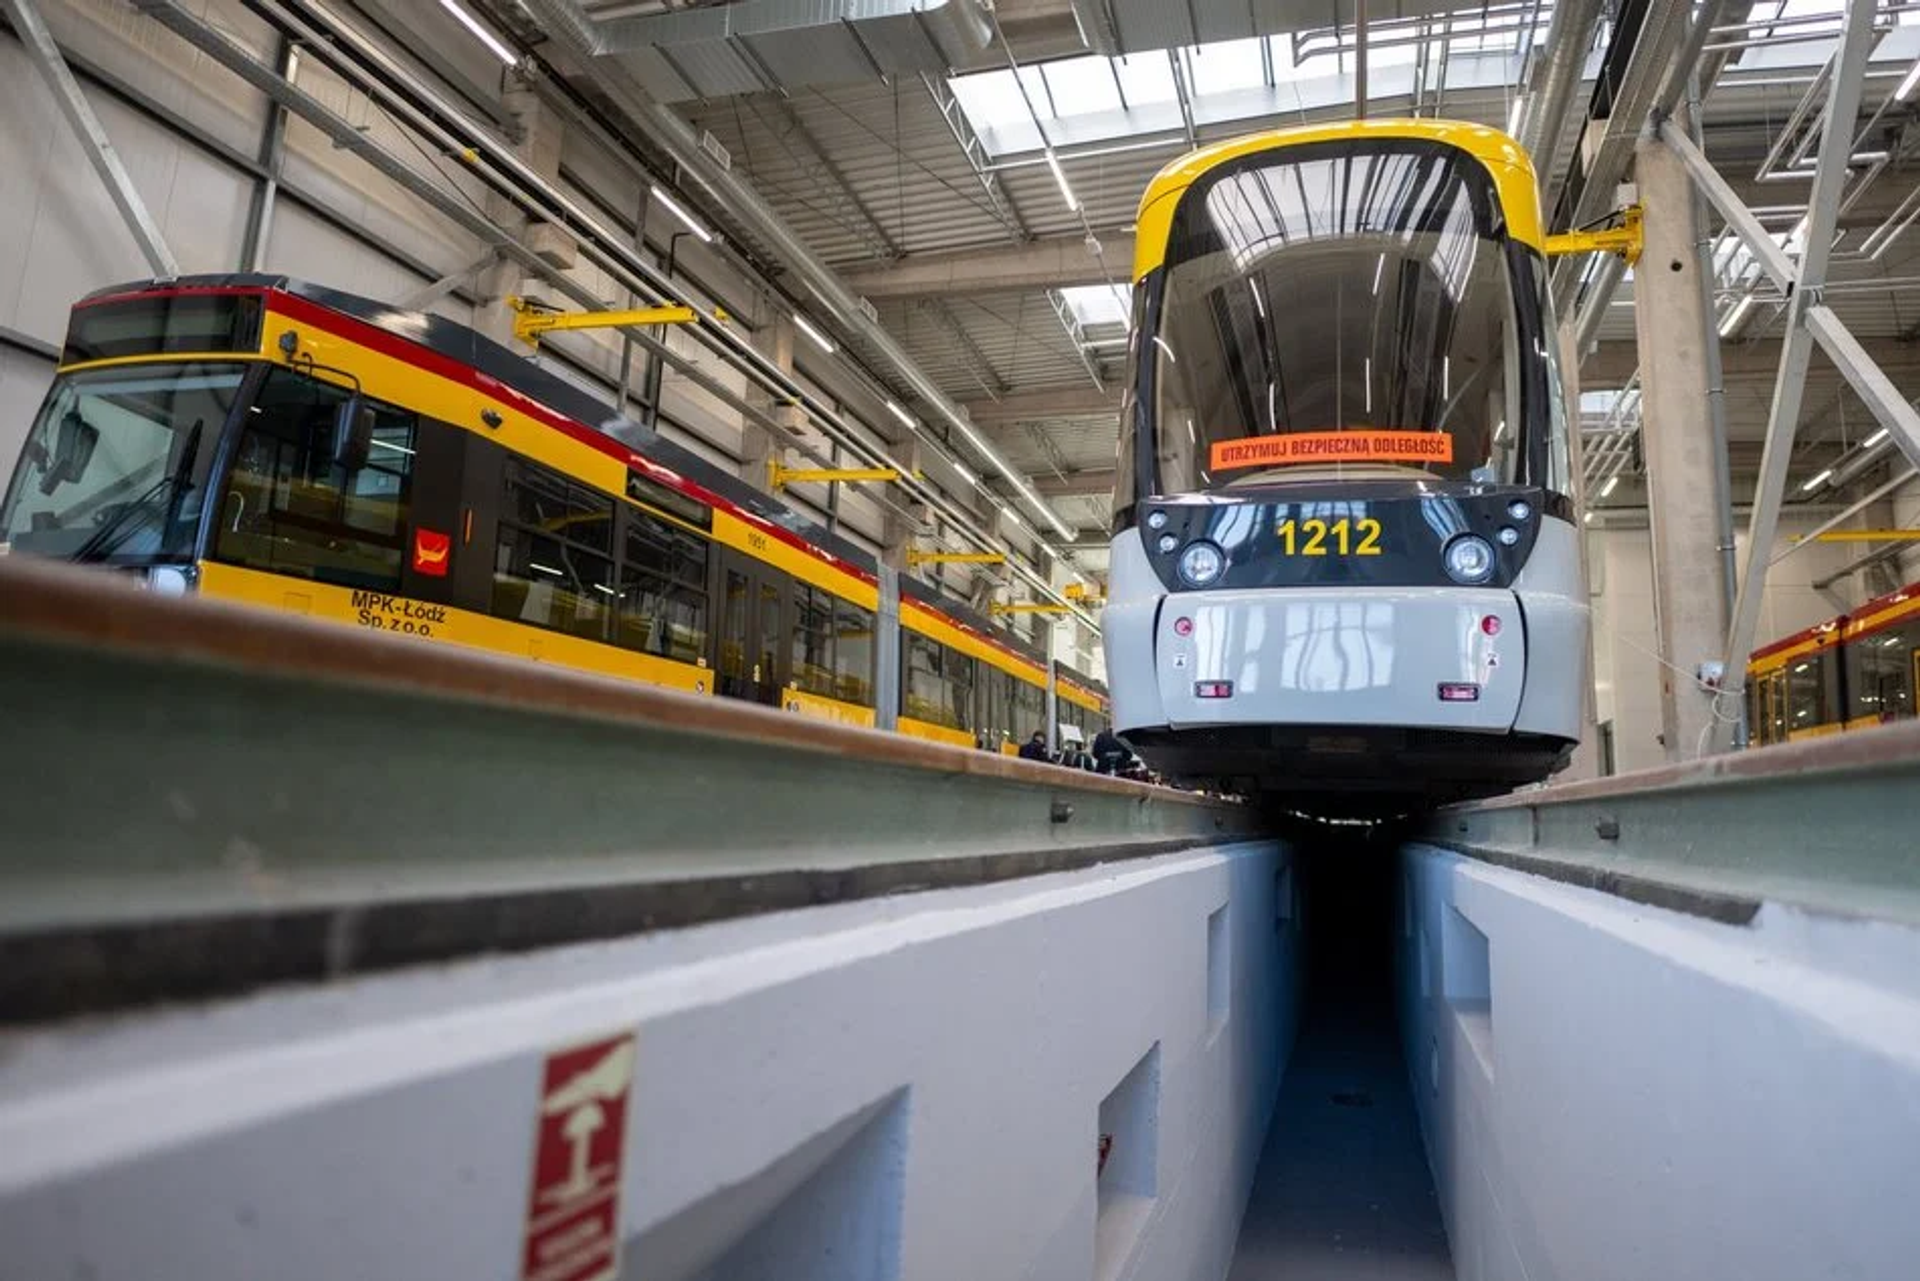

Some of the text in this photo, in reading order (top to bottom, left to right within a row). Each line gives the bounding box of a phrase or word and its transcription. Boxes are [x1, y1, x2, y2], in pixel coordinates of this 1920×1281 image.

[1221, 436, 1444, 462] UTRZYMUJ BEZPIECZNĄ ODLEGŁOŚĆ
[1277, 518, 1382, 556] 1212
[351, 590, 446, 623] MPK-Łódź
